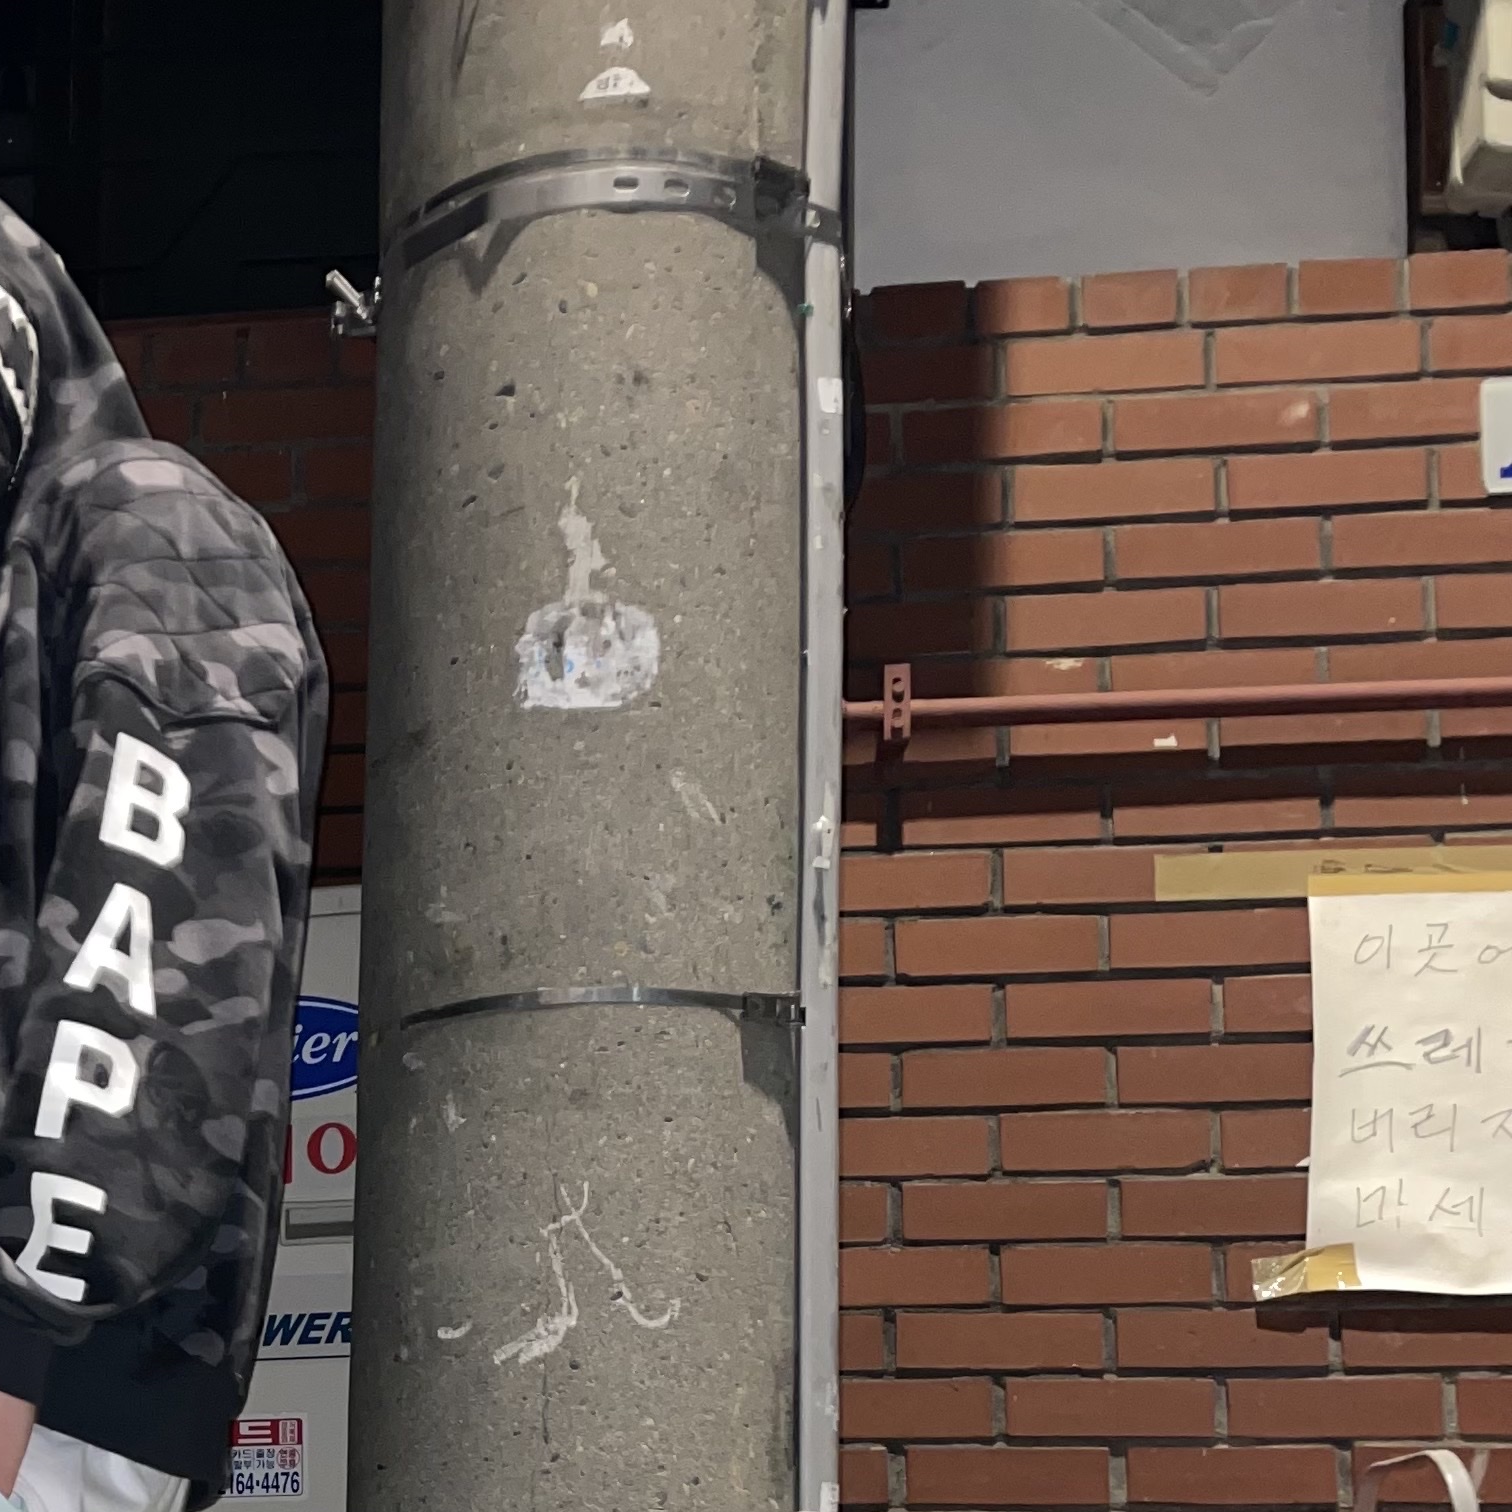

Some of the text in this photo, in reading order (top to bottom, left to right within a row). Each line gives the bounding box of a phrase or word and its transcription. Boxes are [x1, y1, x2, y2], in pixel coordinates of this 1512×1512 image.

[16, 731, 191, 1302] BAPE
[1338, 1024, 1512, 1078] 쓰레
[262, 1311, 353, 1347] WER
